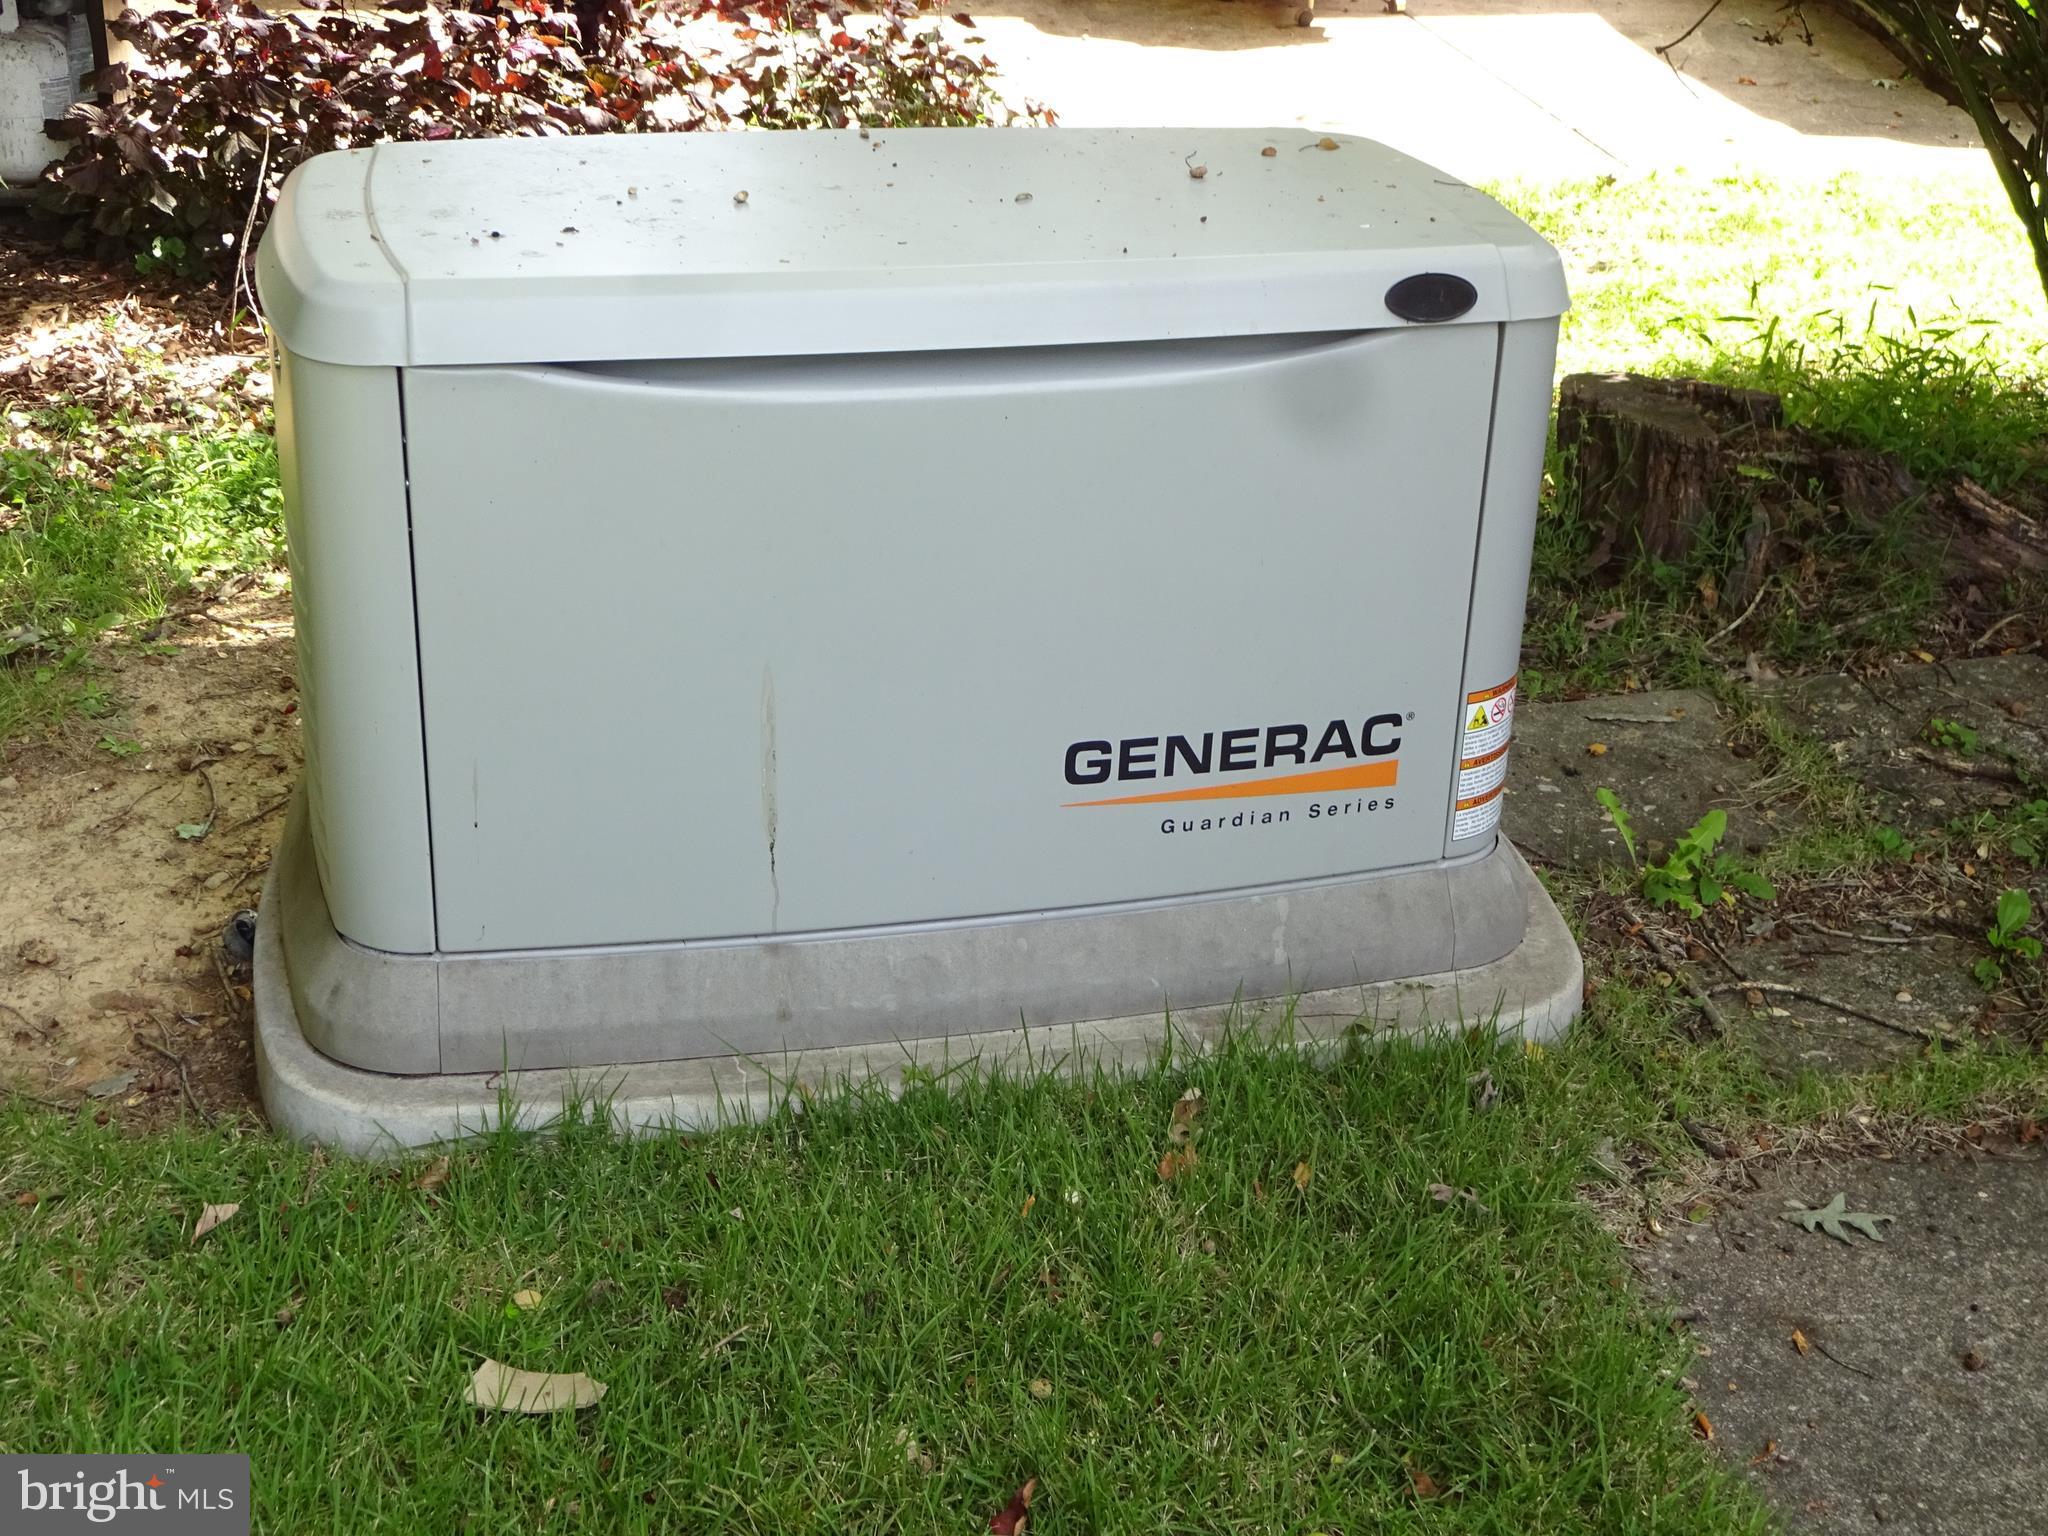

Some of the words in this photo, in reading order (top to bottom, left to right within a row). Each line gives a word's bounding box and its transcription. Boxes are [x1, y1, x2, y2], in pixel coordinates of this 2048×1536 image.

[1064, 713, 1403, 785] GENERAC
[1161, 811, 1290, 834] Guardian
[1308, 797, 1396, 819] Series
